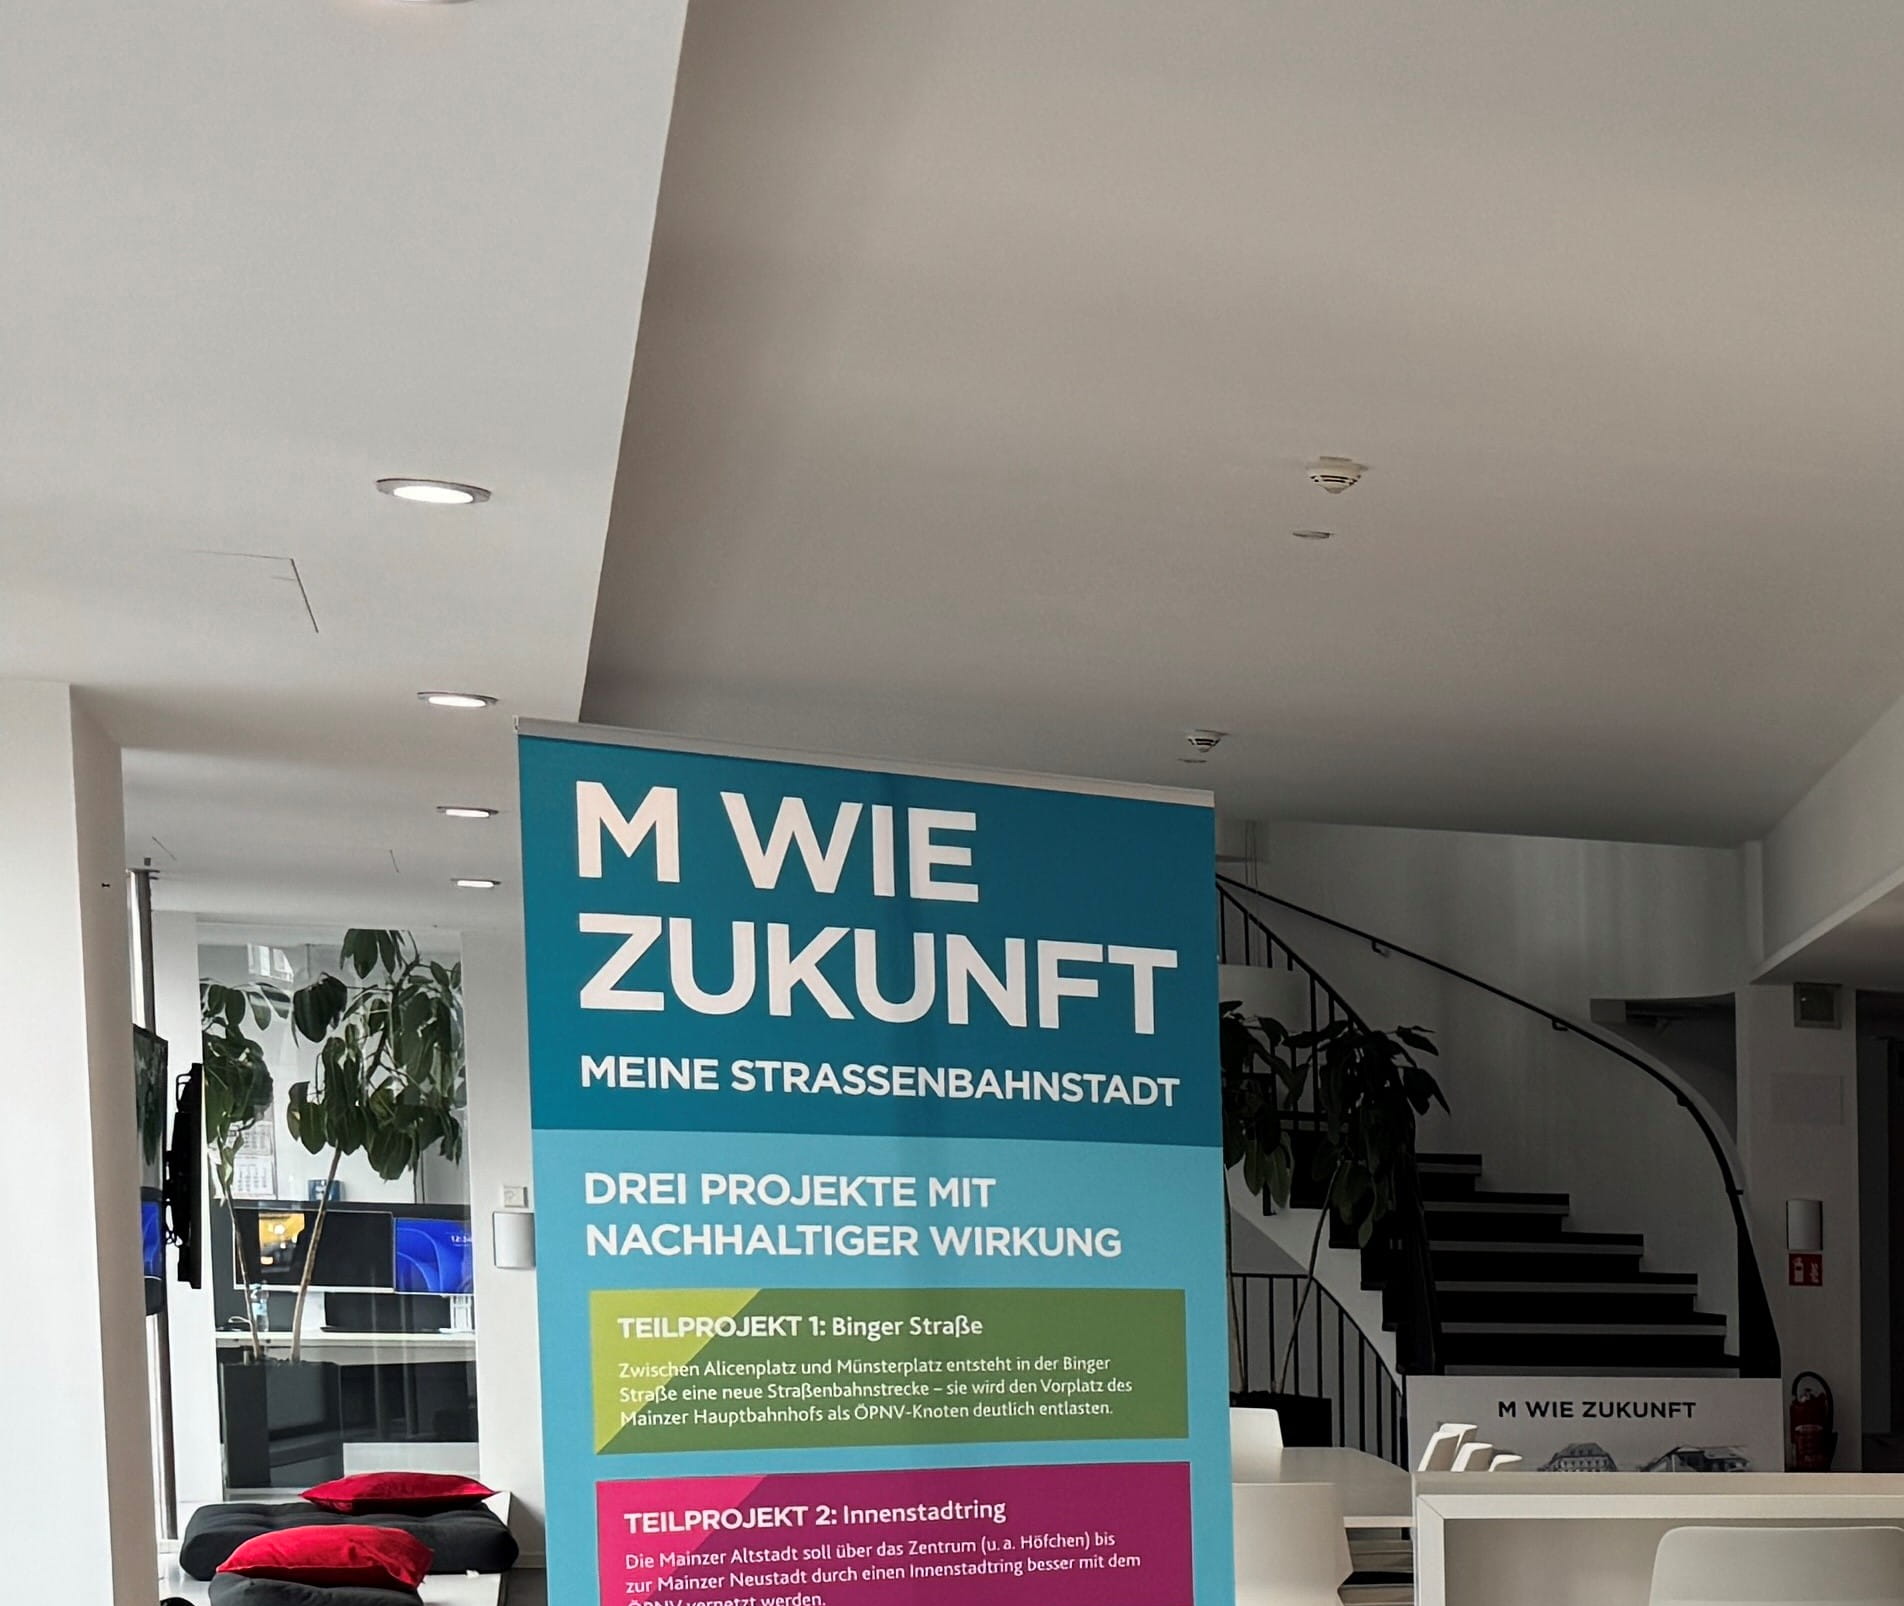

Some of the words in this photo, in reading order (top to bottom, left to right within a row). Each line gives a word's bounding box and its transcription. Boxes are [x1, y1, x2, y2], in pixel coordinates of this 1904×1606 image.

[576, 780, 680, 882] M
[721, 791, 979, 902] WIE
[579, 912, 1178, 1035] ZUKUNFT
[580, 1054, 719, 1091] MEINE
[730, 1058, 1180, 1107] STRASSENBAHNSTADT
[584, 1171, 687, 1205] DREI
[700, 1172, 917, 1207] PROJEKTE
[928, 1176, 997, 1208] MIT
[585, 1222, 919, 1257] NACHHALTIGER
[928, 1225, 1122, 1258] WIRKUNG
[618, 1316, 803, 1338] TEILPROJEKT
[807, 1315, 826, 1336] 1:
[831, 1315, 904, 1342] Binger
[908, 1314, 983, 1338] Straße
[619, 1360, 701, 1379] Zwischen
[703, 1359, 798, 1378] Alicenplatz
[800, 1357, 832, 1375] und
[836, 1356, 943, 1377] Münsterplatz
[945, 1355, 1012, 1372] entsteht
[1015, 1355, 1030, 1371] in
[1033, 1354, 1059, 1371] der
[1062, 1354, 1111, 1375] Binger
[619, 1383, 678, 1404] Straße
[681, 1383, 718, 1401] eine
[721, 1386, 763, 1400] neue
[766, 1379, 929, 1401] Straßenbahnstrecke
[945, 1379, 968, 1395] sie
[970, 1378, 1005, 1394] wird
[1008, 1377, 1037, 1394] den
[1039, 1376, 1104, 1397] Vorplatz
[1106, 1376, 1133, 1392] des
[619, 1408, 689, 1428] Mainzer
[693, 1404, 824, 1427] Hauptbahnhofs
[826, 1403, 851, 1421] als
[853, 1402, 969, 1420] ÖPNV-Knoten
[972, 1399, 1035, 1418] deutlich
[1038, 1399, 1113, 1416] entlasten.
[1498, 1401, 1516, 1418] M
[1525, 1401, 1574, 1418] WIE
[1582, 1401, 1697, 1418] ZUKUNFT
[622, 1504, 809, 1534] TEILPROJEKT
[814, 1503, 837, 1526] 2:
[842, 1498, 1006, 1524] Innenstadtring
[625, 1552, 654, 1570] Die
[658, 1550, 727, 1567] Mainzer
[729, 1544, 799, 1564] Altstadt
[802, 1543, 832, 1561] soll
[835, 1542, 873, 1559] über
[875, 1540, 904, 1557] das
[907, 1539, 976, 1555] Zentrum
[1019, 1530, 1090, 1551] Höfchen)
[1094, 1530, 1116, 1546] bis
[625, 1580, 653, 1594] zur
[657, 1573, 725, 1592] Mainzer
[729, 1567, 807, 1588] Neustadt
[810, 1565, 858, 1583] durch
[860, 1564, 905, 1581] einen
[909, 1557, 1024, 1578] Innenstadtring
[1026, 1556, 1075, 1572] besser
[1078, 1553, 1105, 1569] mit
[1107, 1552, 1141, 1568] dem
